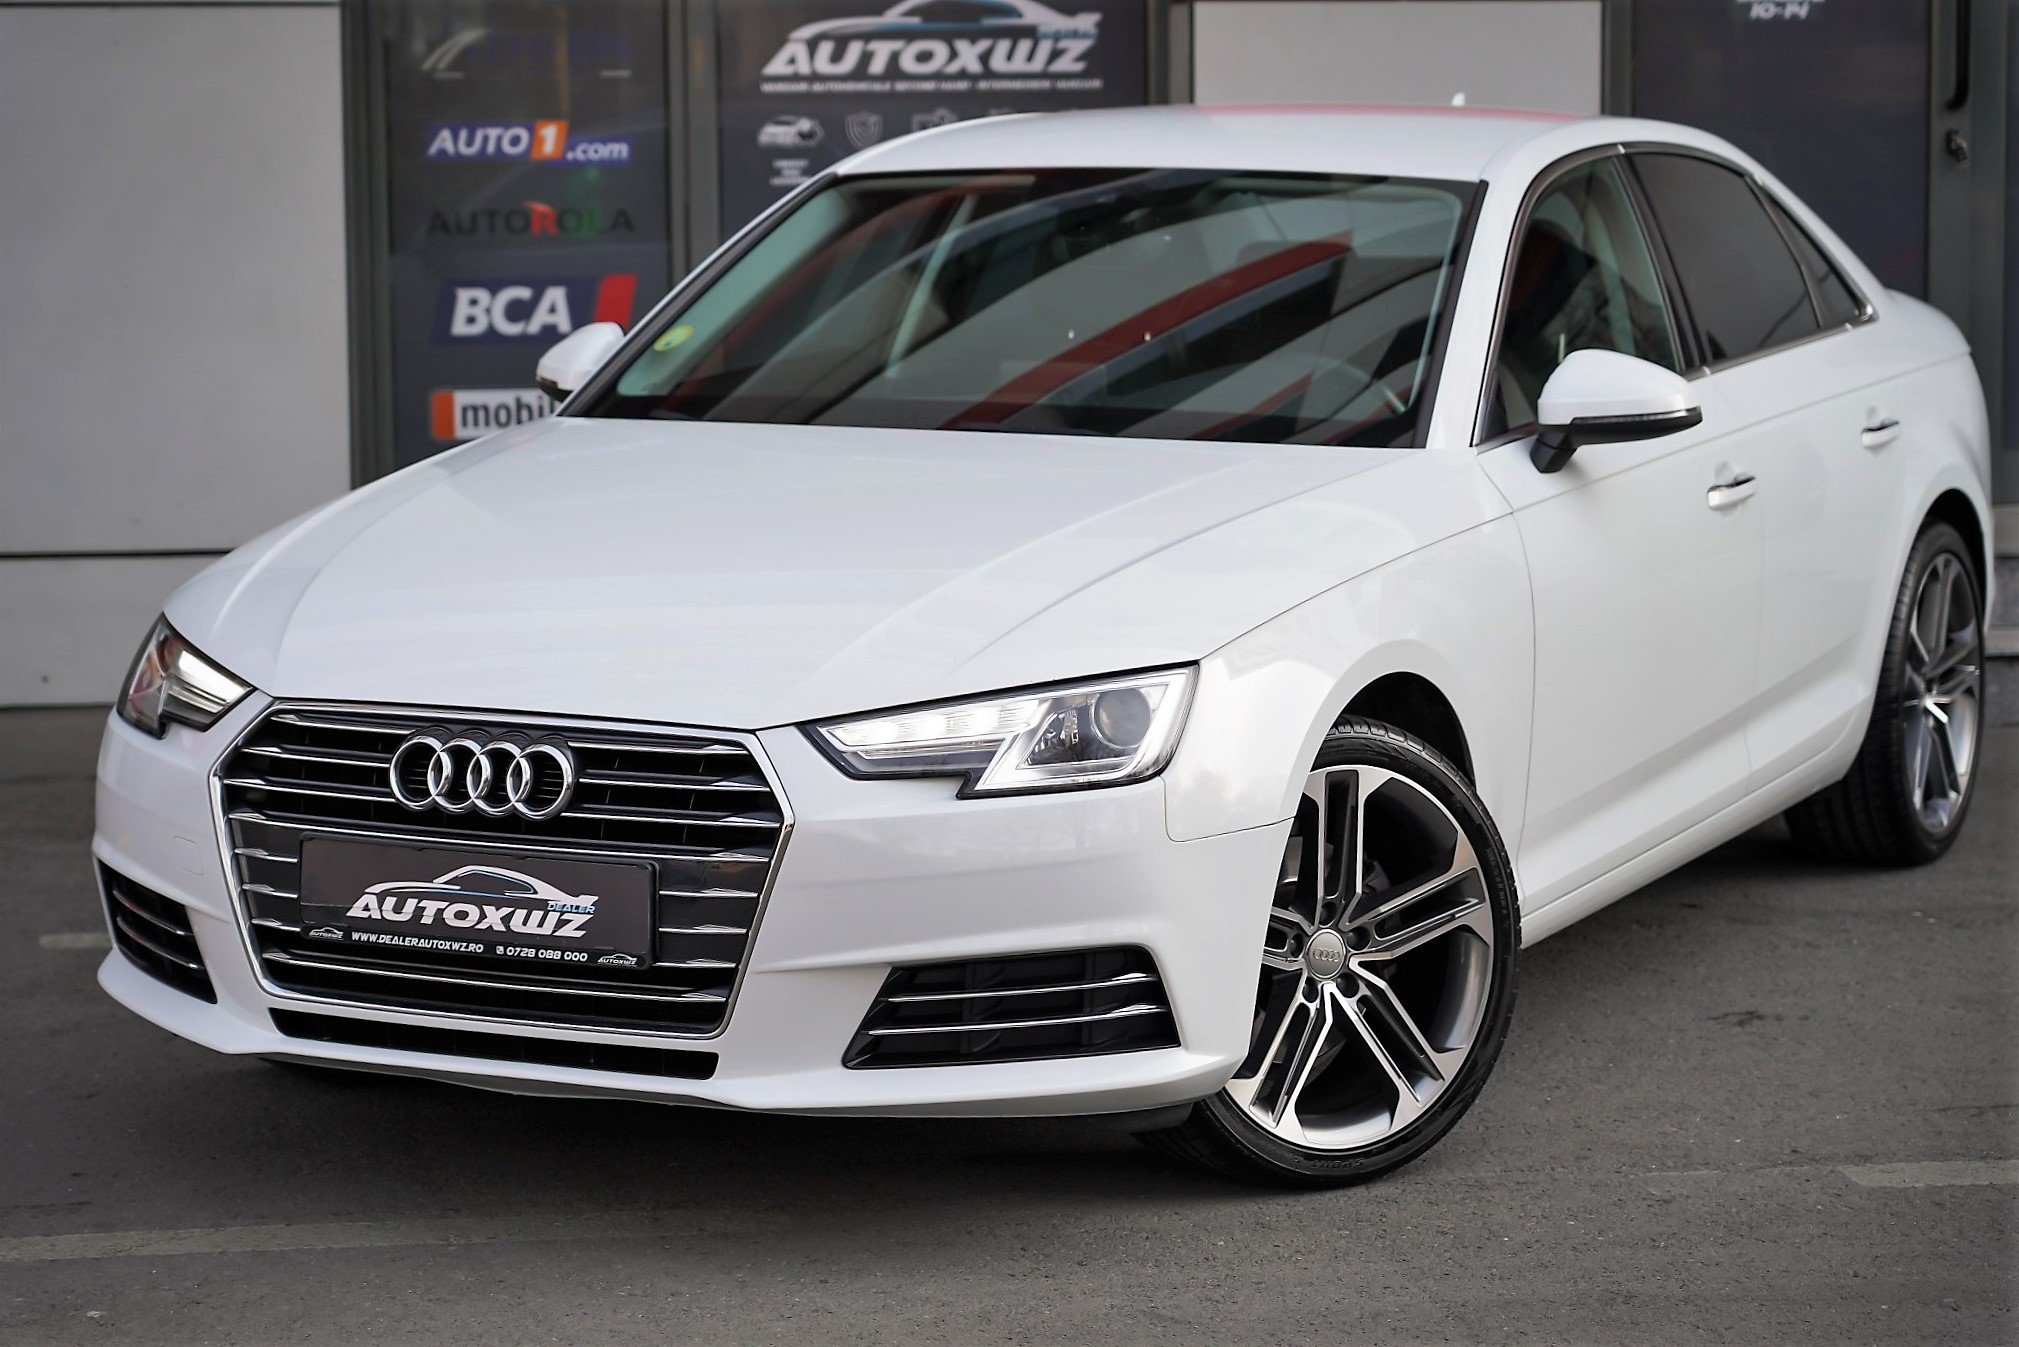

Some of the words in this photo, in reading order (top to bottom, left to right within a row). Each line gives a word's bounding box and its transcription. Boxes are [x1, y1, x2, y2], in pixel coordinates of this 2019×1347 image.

[762, 38, 1097, 76] AUTOXWZ
[426, 201, 635, 236] AUTOROLA
[451, 285, 573, 336] BCA
[346, 893, 595, 938] AUTOXWZ
[546, 901, 596, 914] DEALER
[351, 931, 484, 952] WWW.DEALERAUTOXWZ.RO
[506, 946, 536, 958] 0728
[538, 949, 562, 960] 088
[564, 951, 588, 962] 000
